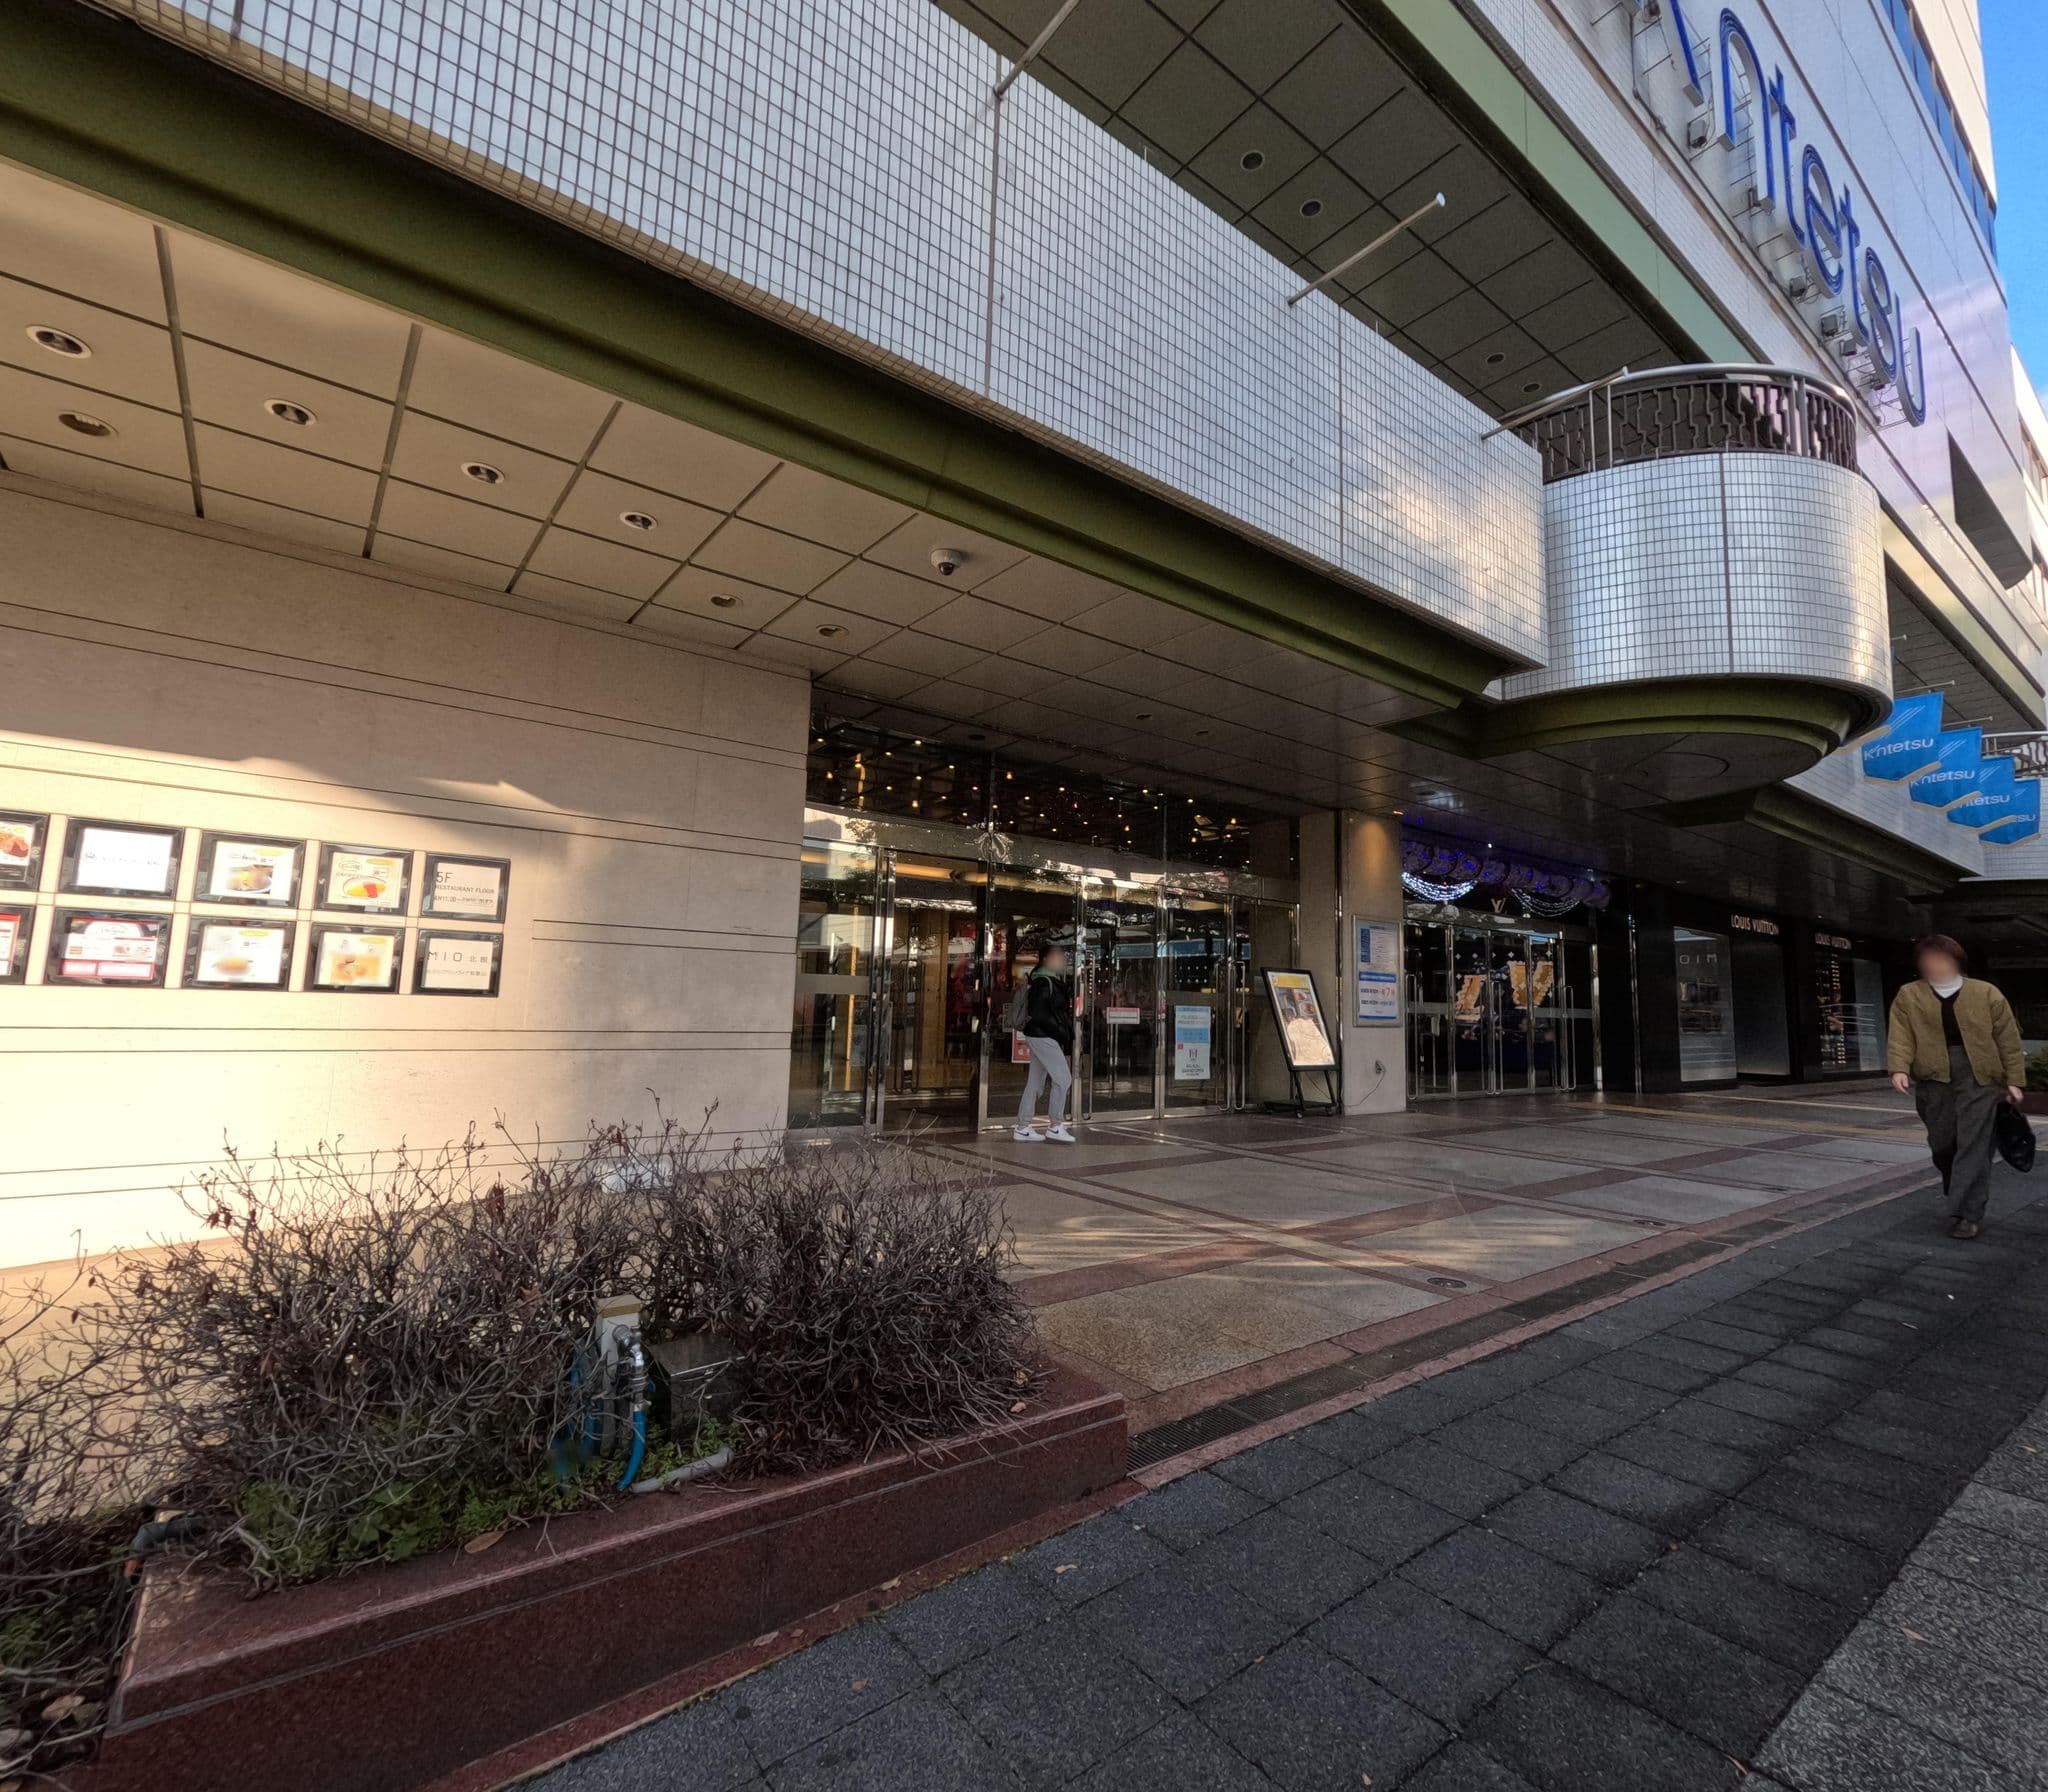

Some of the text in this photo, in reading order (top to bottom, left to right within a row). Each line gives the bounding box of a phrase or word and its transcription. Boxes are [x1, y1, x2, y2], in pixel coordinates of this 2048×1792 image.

[436, 871, 453, 883] 5F
[1731, 914, 1780, 936] LOUIS VUITTON
[427, 952, 463, 962] MIO
